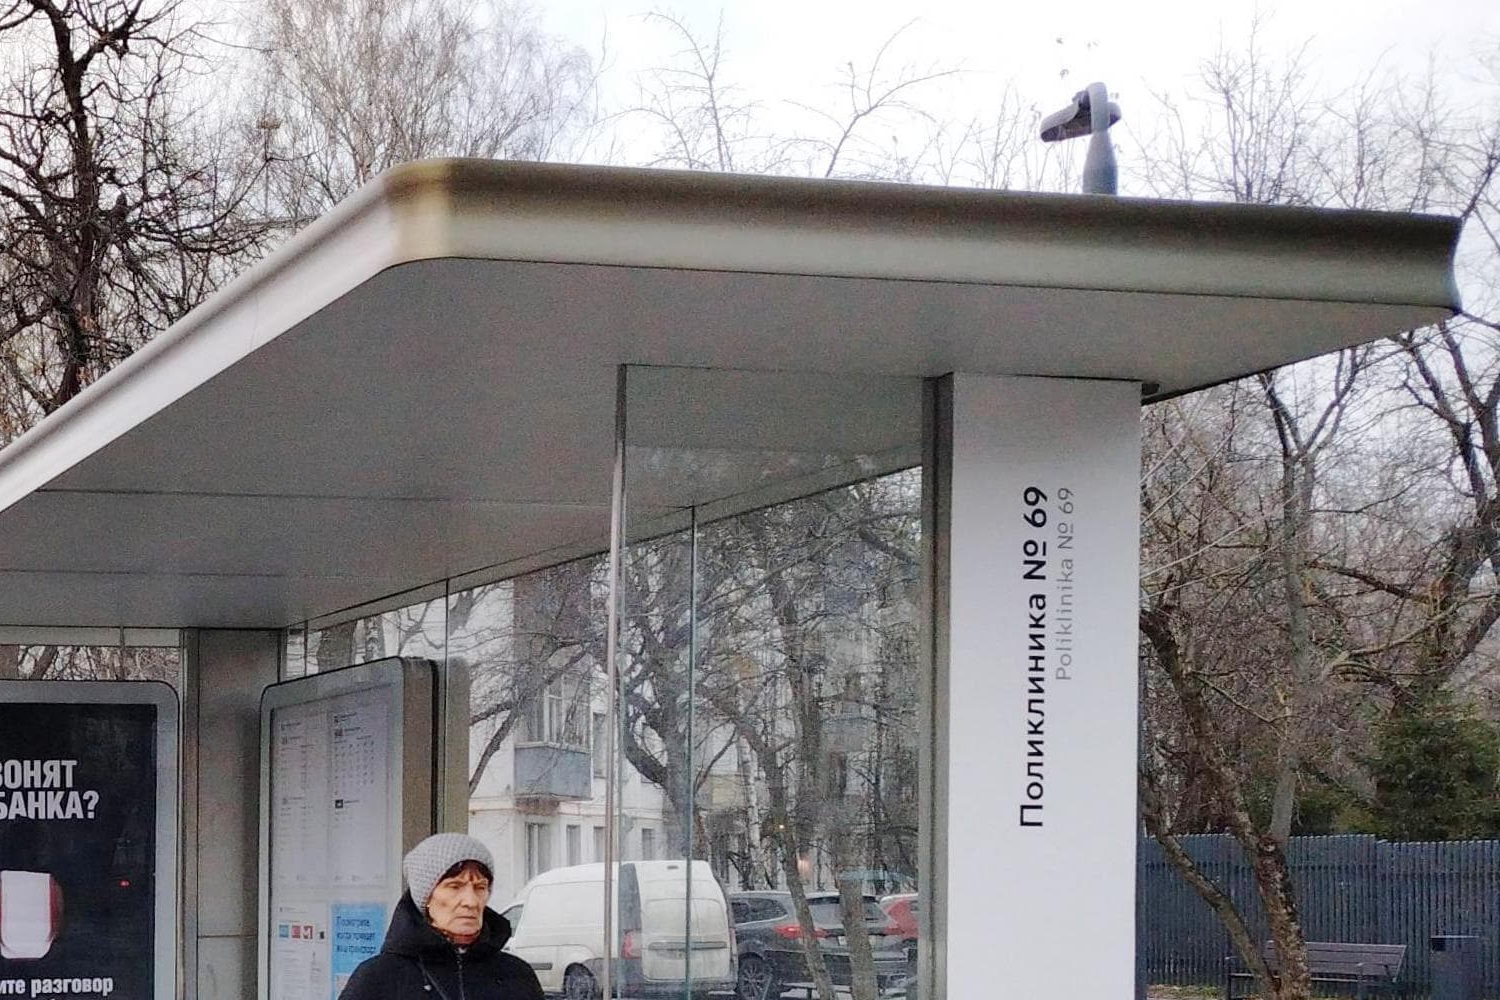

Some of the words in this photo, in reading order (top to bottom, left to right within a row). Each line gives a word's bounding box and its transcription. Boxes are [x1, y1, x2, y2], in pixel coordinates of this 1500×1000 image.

[1023, 486, 1048, 528] 69
[1057, 487, 1075, 514] 69
[1057, 522, 1074, 549] №
[1023, 539, 1047, 580] №
[1055, 558, 1074, 681] Poliklinika
[1019, 593, 1047, 828] Поликлиника
[31, 977, 113, 998] разговор
